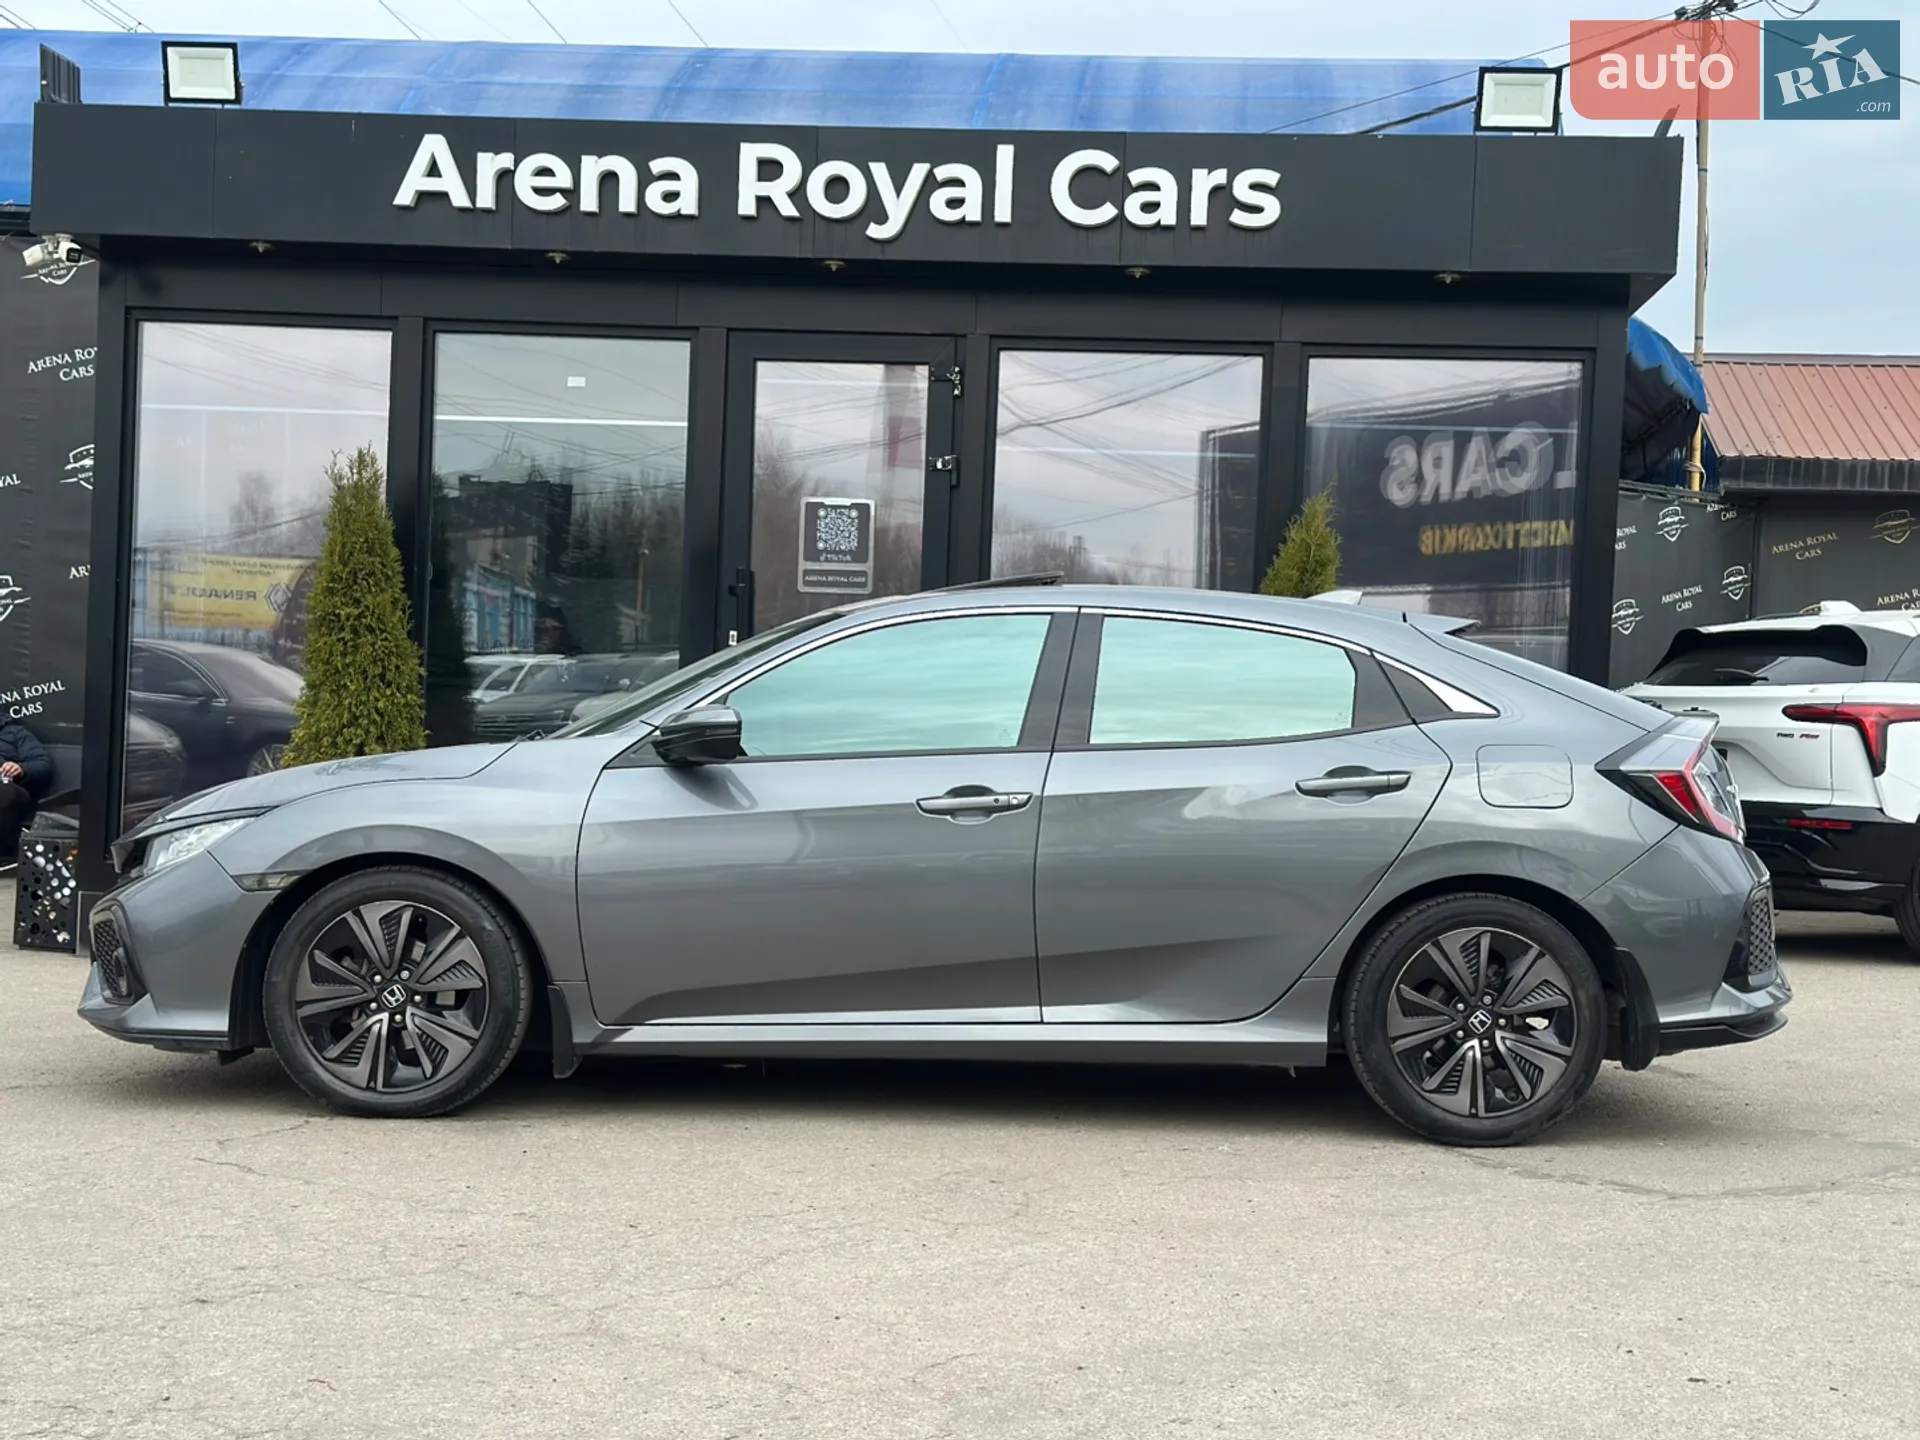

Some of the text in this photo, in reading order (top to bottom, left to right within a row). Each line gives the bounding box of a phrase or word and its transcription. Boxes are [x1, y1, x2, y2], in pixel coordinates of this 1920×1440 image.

[392, 133, 1282, 241] Arena Royal Cars
[27, 346, 98, 374] ARENA RO
[59, 364, 94, 381] CARS
[1771, 532, 1839, 554] ARENA ROYAL
[1795, 549, 1822, 560] CARS
[69, 564, 90, 579] AR
[1877, 592, 1910, 606] ARENA
[0, 680, 66, 703] NA ROYAL
[10, 701, 43, 718] CARS
